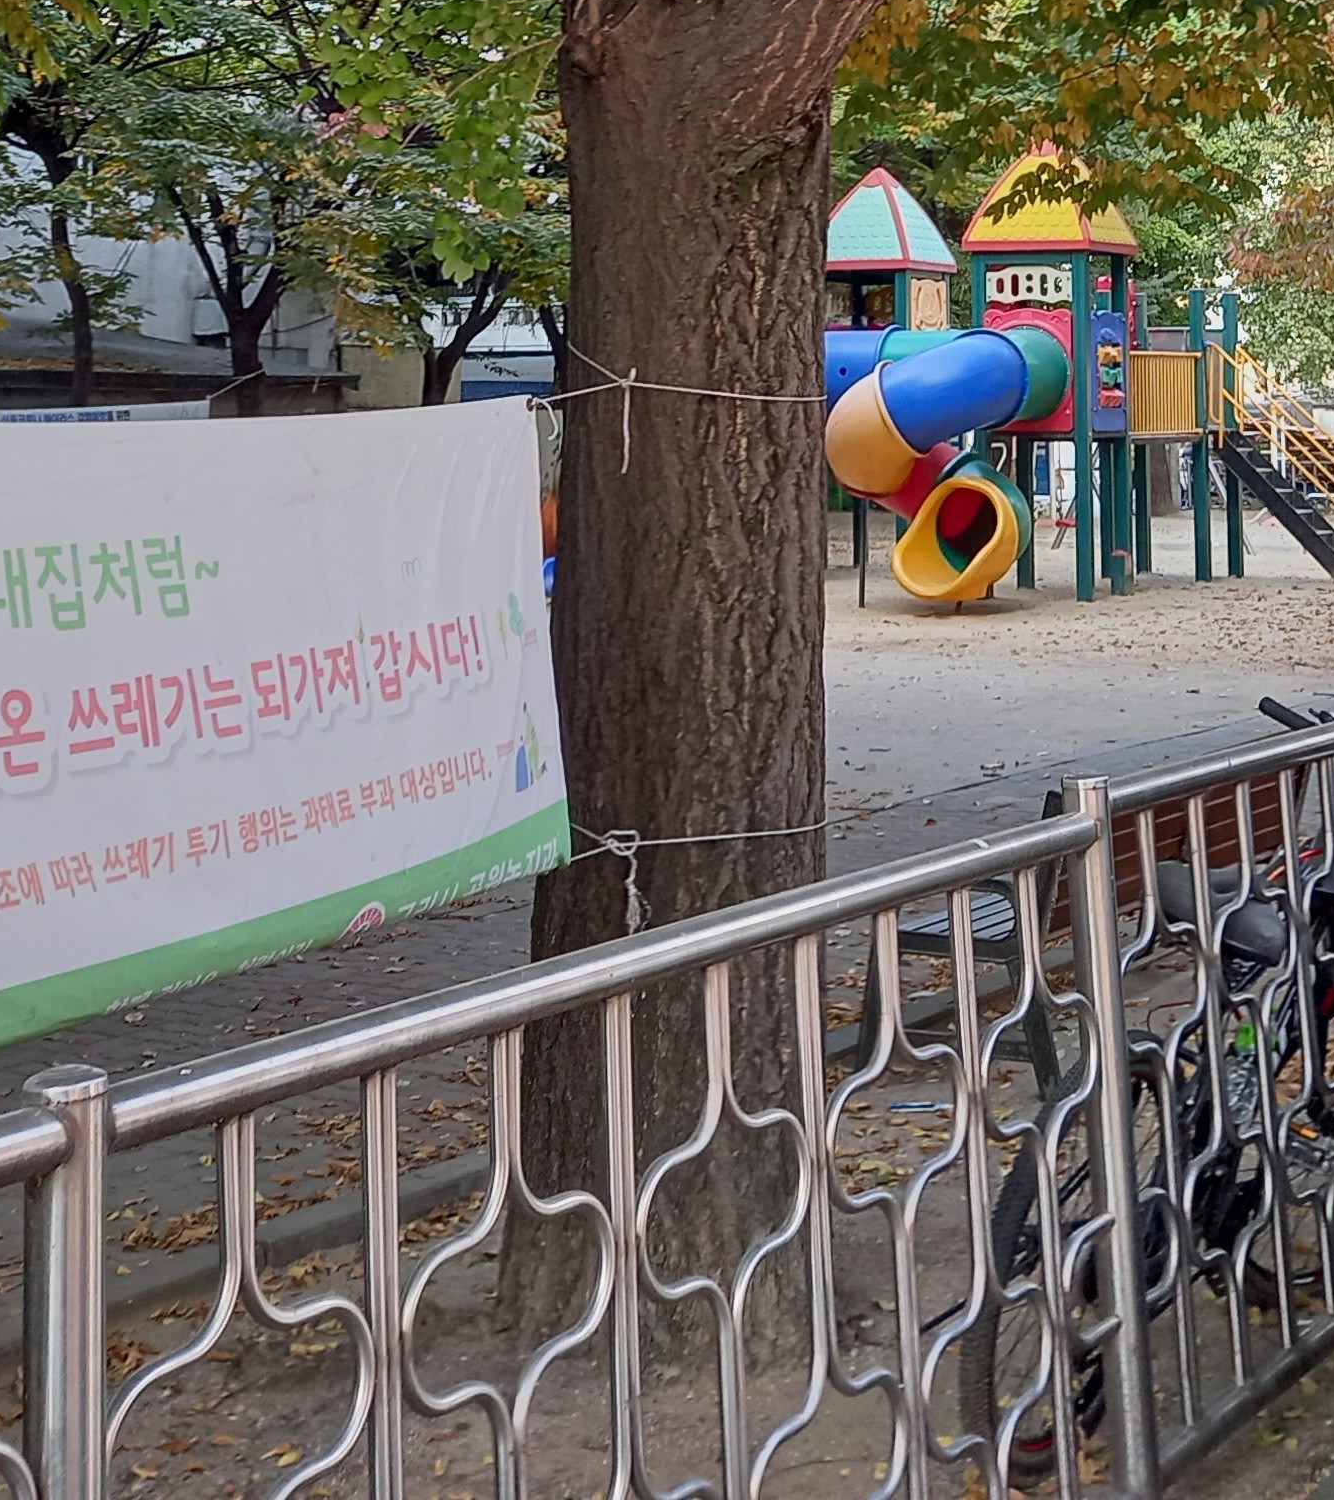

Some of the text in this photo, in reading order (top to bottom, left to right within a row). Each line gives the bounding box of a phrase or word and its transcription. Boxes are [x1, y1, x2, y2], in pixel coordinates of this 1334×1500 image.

[68, 665, 242, 755] 쓰레기는
[250, 640, 361, 721] 되가져
[370, 615, 483, 701] 갑시다!
[48, 851, 98, 899] 따라
[102, 831, 176, 885] 쓰레기
[185, 819, 233, 868] 투기
[238, 804, 299, 855] 행위는
[300, 788, 356, 835] 과태료
[358, 774, 396, 819] 부과
[399, 746, 493, 805] 대상입니다.
